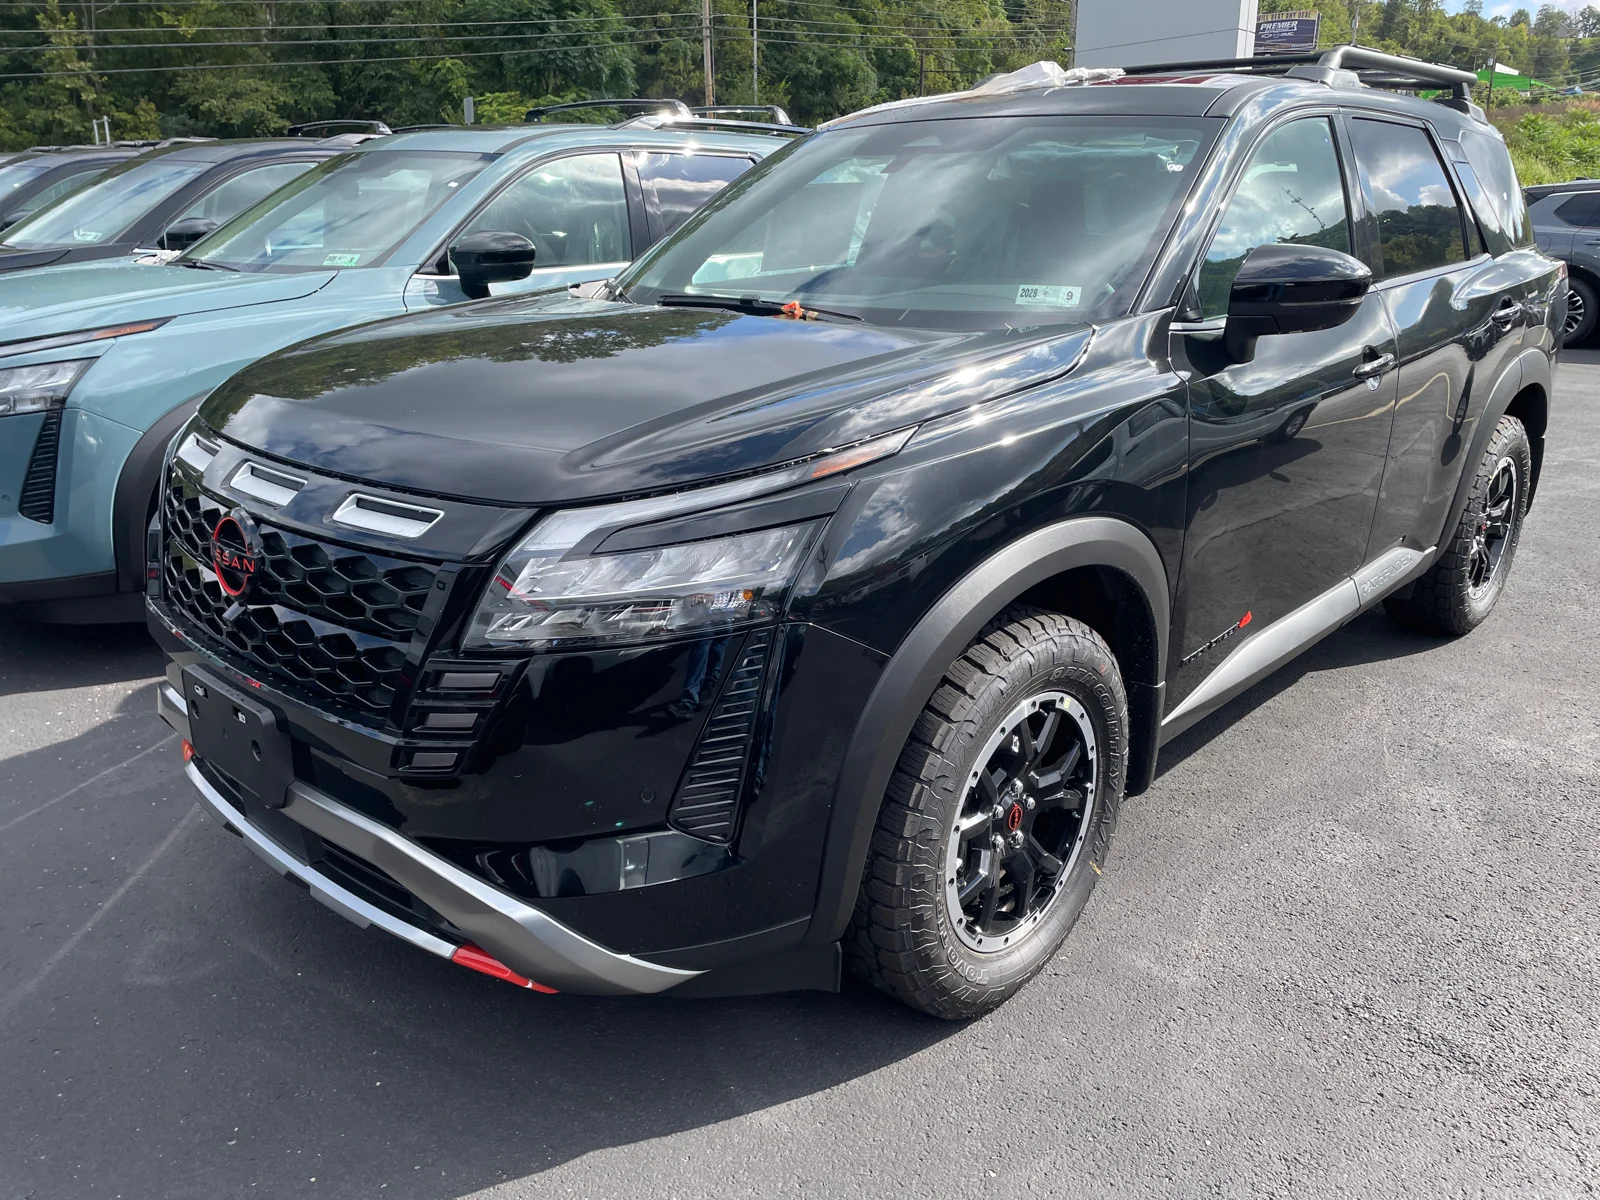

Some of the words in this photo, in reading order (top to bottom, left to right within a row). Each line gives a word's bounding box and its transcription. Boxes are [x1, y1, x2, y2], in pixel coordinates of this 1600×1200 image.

[1260, 21, 1298, 31] PREMIER
[1020, 288, 1039, 298] 2028
[1066, 291, 1074, 301] 9
[1049, 666, 1098, 687] OPEN
[1093, 683, 1120, 791] COUNTRY
[947, 947, 990, 986] TOYO
